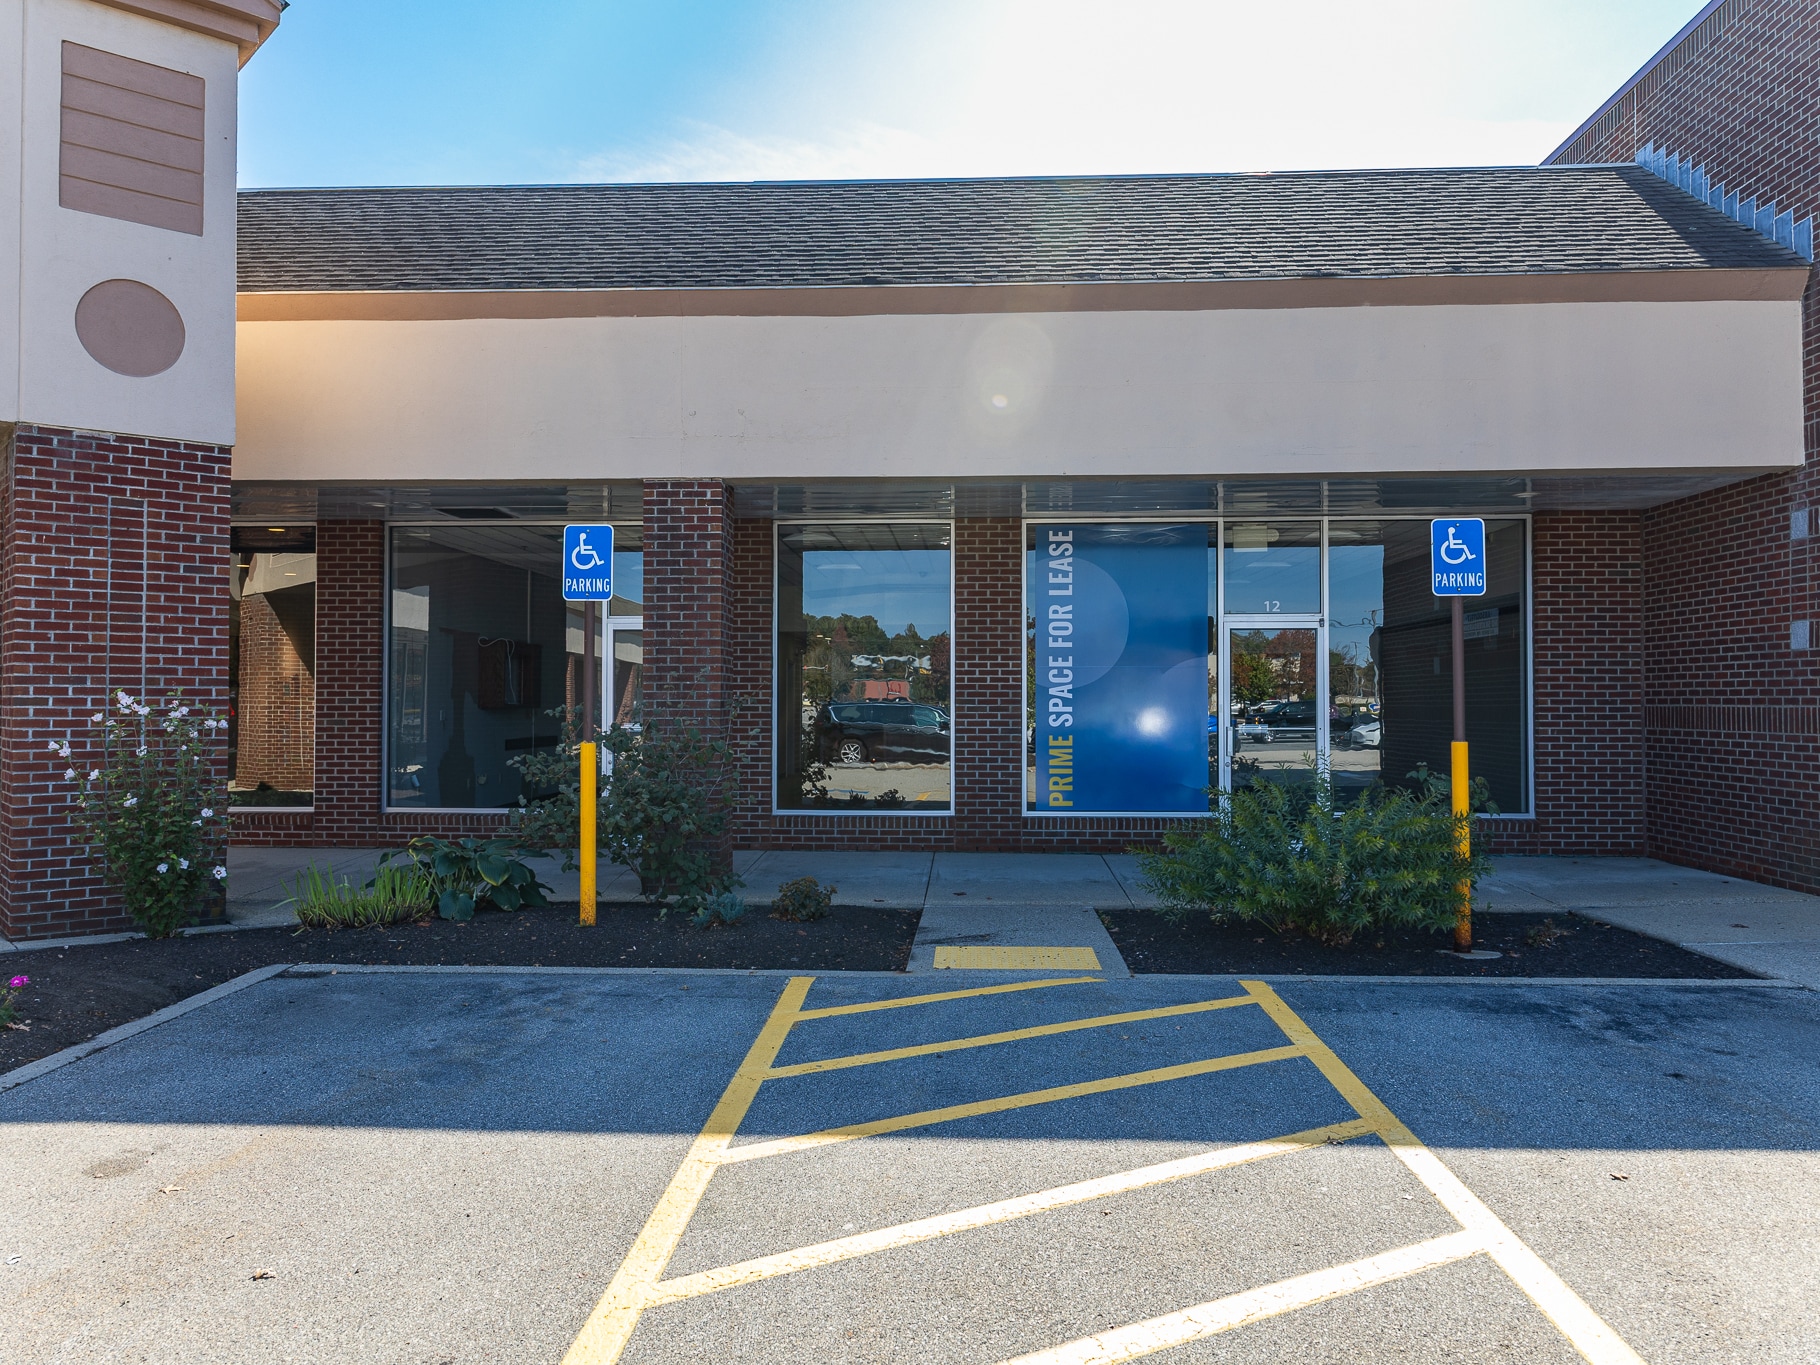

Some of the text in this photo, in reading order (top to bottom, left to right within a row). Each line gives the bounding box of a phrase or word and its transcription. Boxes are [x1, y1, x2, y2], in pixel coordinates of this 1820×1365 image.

[565, 578, 610, 592] PARKING
[1435, 572, 1483, 587] PARKING
[1263, 600, 1281, 612] 12
[1048, 530, 1073, 807] PRIME SPACE FOR LEASE
